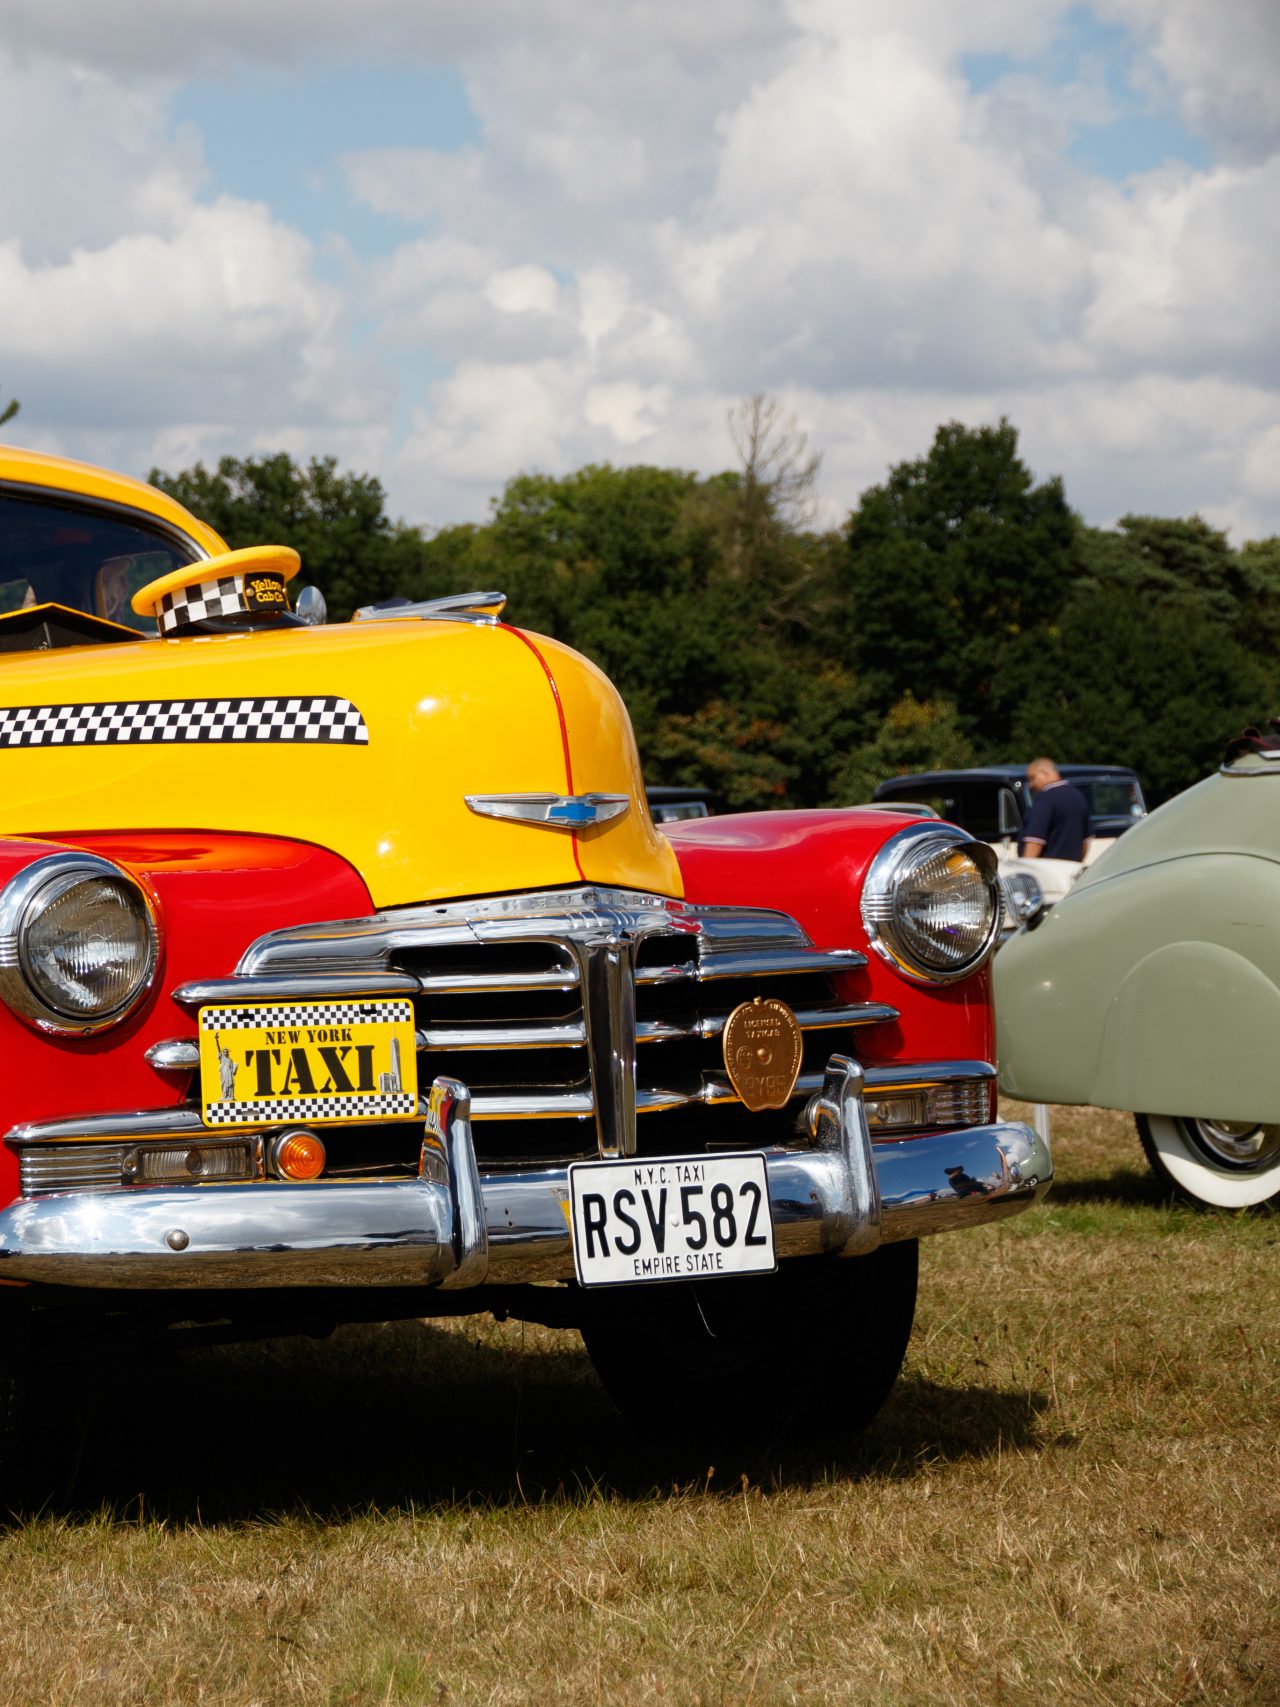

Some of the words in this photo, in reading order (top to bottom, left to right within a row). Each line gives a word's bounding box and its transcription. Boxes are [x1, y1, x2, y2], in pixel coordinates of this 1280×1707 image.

[250, 578, 282, 592] Yellow
[256, 591, 274, 603] Cab
[265, 1030, 301, 1045] NEW
[307, 1028, 353, 1043] YORK
[245, 1045, 377, 1097] TAXI
[675, 1165, 705, 1183] TAXI
[634, 1256, 681, 1276] EMPIRE
[686, 1252, 724, 1272] STATE
